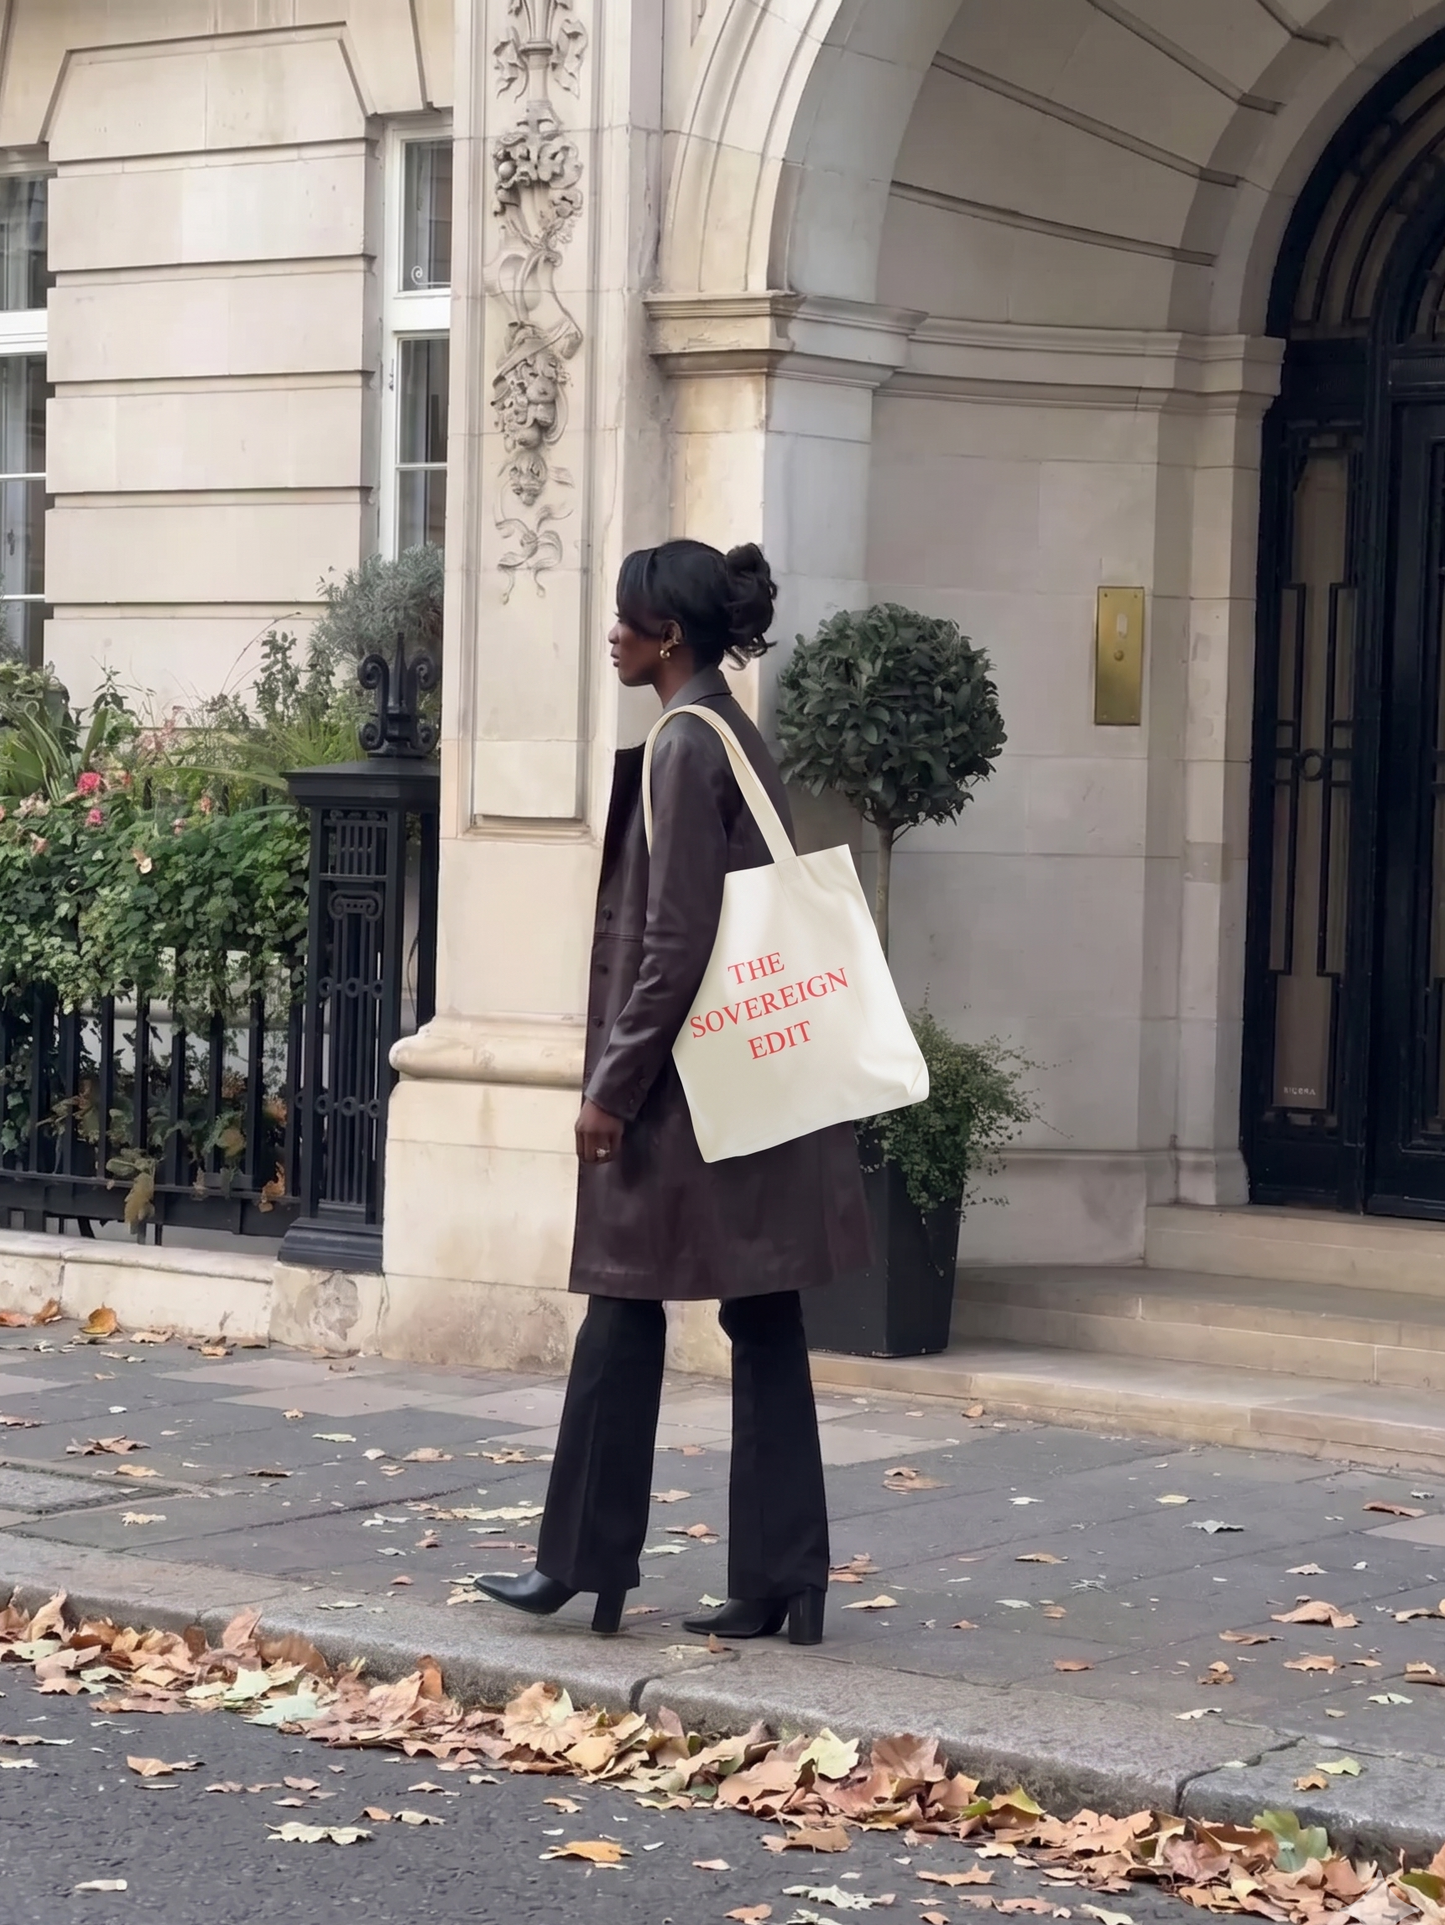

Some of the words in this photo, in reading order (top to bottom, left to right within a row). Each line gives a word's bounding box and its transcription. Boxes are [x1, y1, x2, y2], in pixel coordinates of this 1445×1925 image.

[728, 952, 785, 985] THE
[690, 967, 848, 1039] SOVEREIGN
[748, 1020, 811, 1060] EDIT
